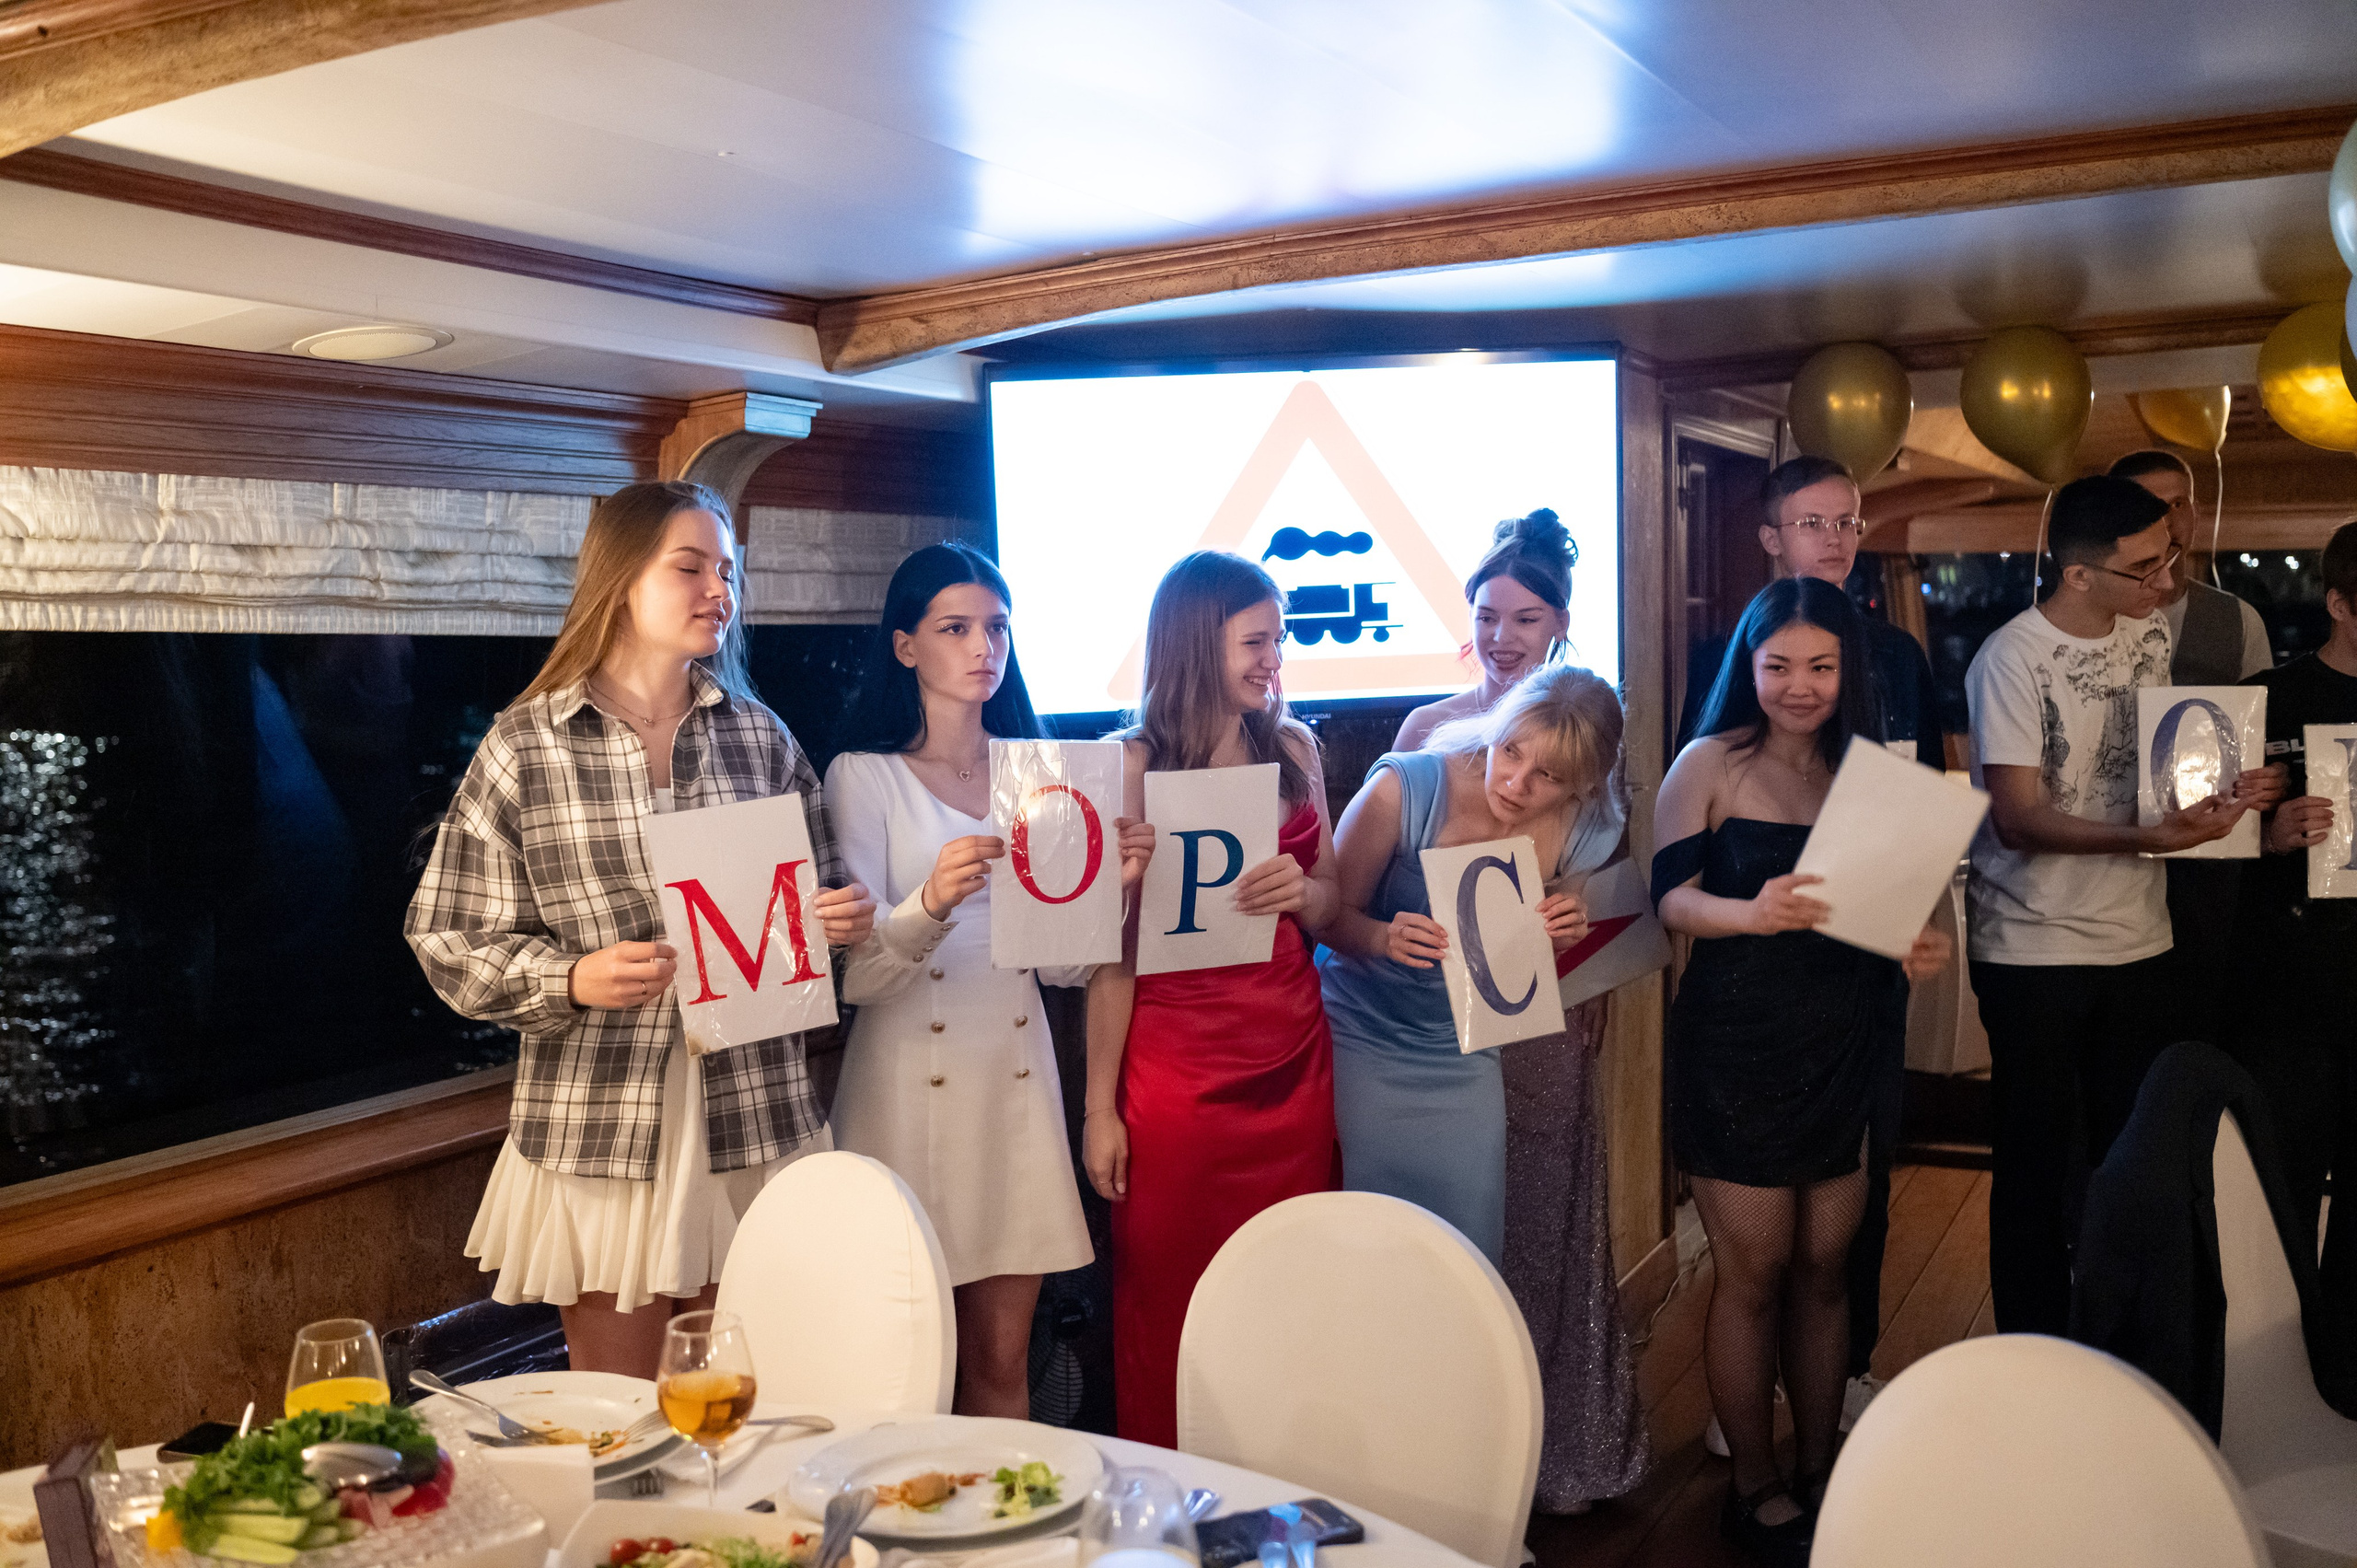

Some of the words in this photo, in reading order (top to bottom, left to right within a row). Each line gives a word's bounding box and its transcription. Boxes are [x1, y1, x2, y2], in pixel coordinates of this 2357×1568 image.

[1011, 784, 1104, 905] О
[1164, 829, 1245, 935] Р
[664, 858, 827, 1006] М
[1456, 851, 1538, 1016] С
